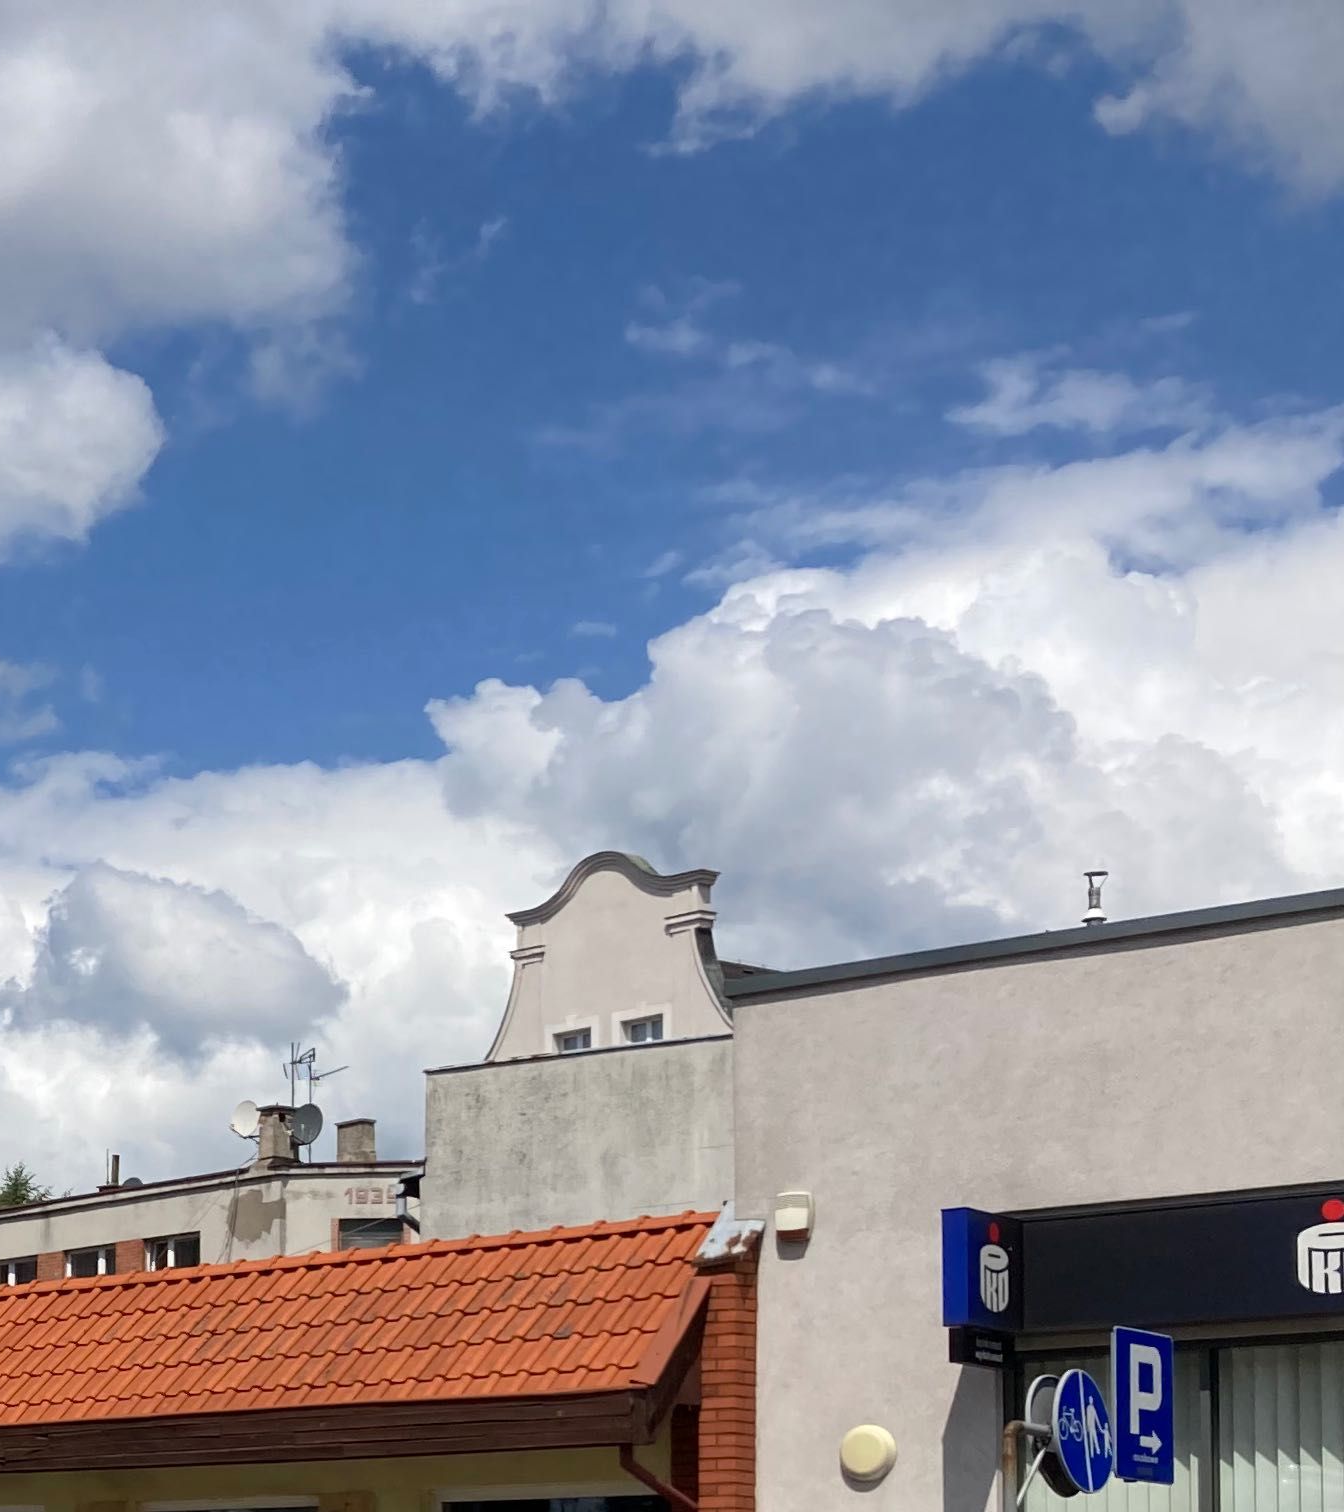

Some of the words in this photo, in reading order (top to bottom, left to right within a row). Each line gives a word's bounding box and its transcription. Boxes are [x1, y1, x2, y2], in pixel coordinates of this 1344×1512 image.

[979, 1244, 1010, 1313] PKO
[1297, 1222, 1344, 1294] PK
[1129, 1343, 1162, 1435] P
